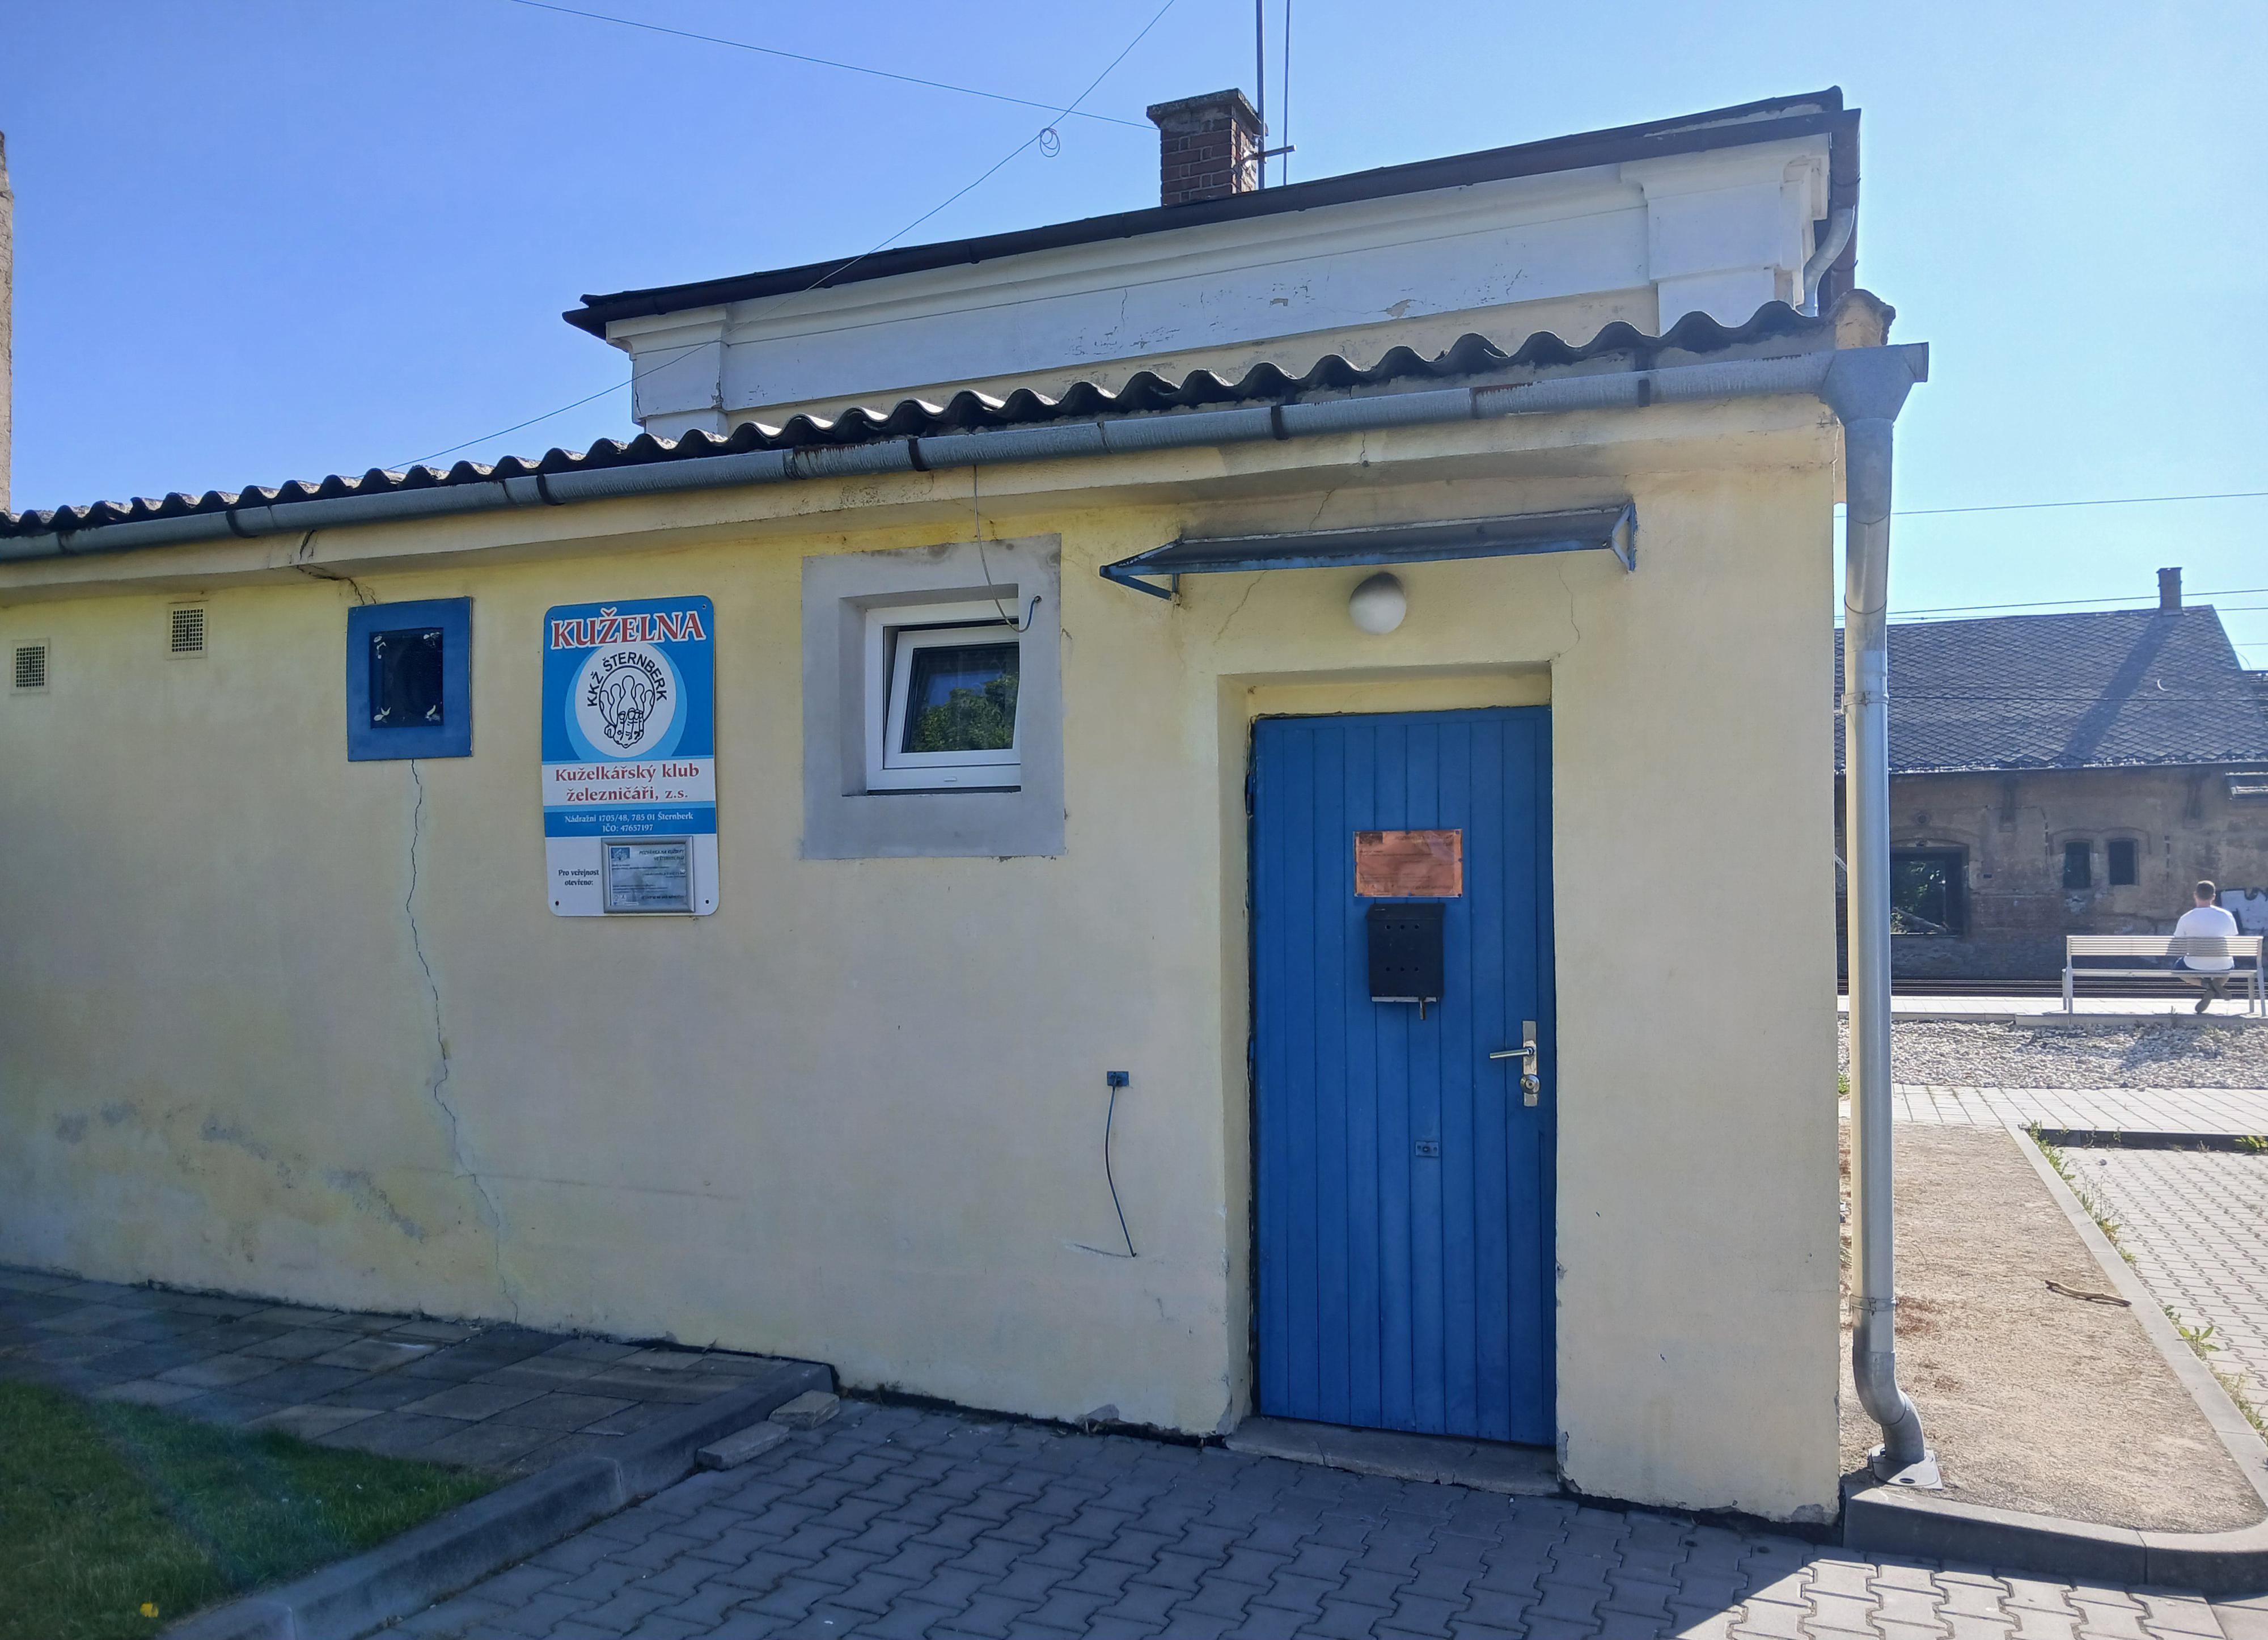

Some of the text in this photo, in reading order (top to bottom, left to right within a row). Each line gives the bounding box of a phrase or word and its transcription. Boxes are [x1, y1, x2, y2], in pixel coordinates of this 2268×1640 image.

[552, 608, 705, 648] KUŽELNA
[587, 652, 667, 707] KKŽ ŠTERNBERK
[556, 763, 700, 782] Kuželkářský klub
[566, 786, 688, 802] železničáři, z.s.
[565, 814, 596, 823] Nádražní
[658, 811, 693, 820] Šternberk
[603, 823, 619, 832] IČO:
[570, 869, 599, 877] veřejnost
